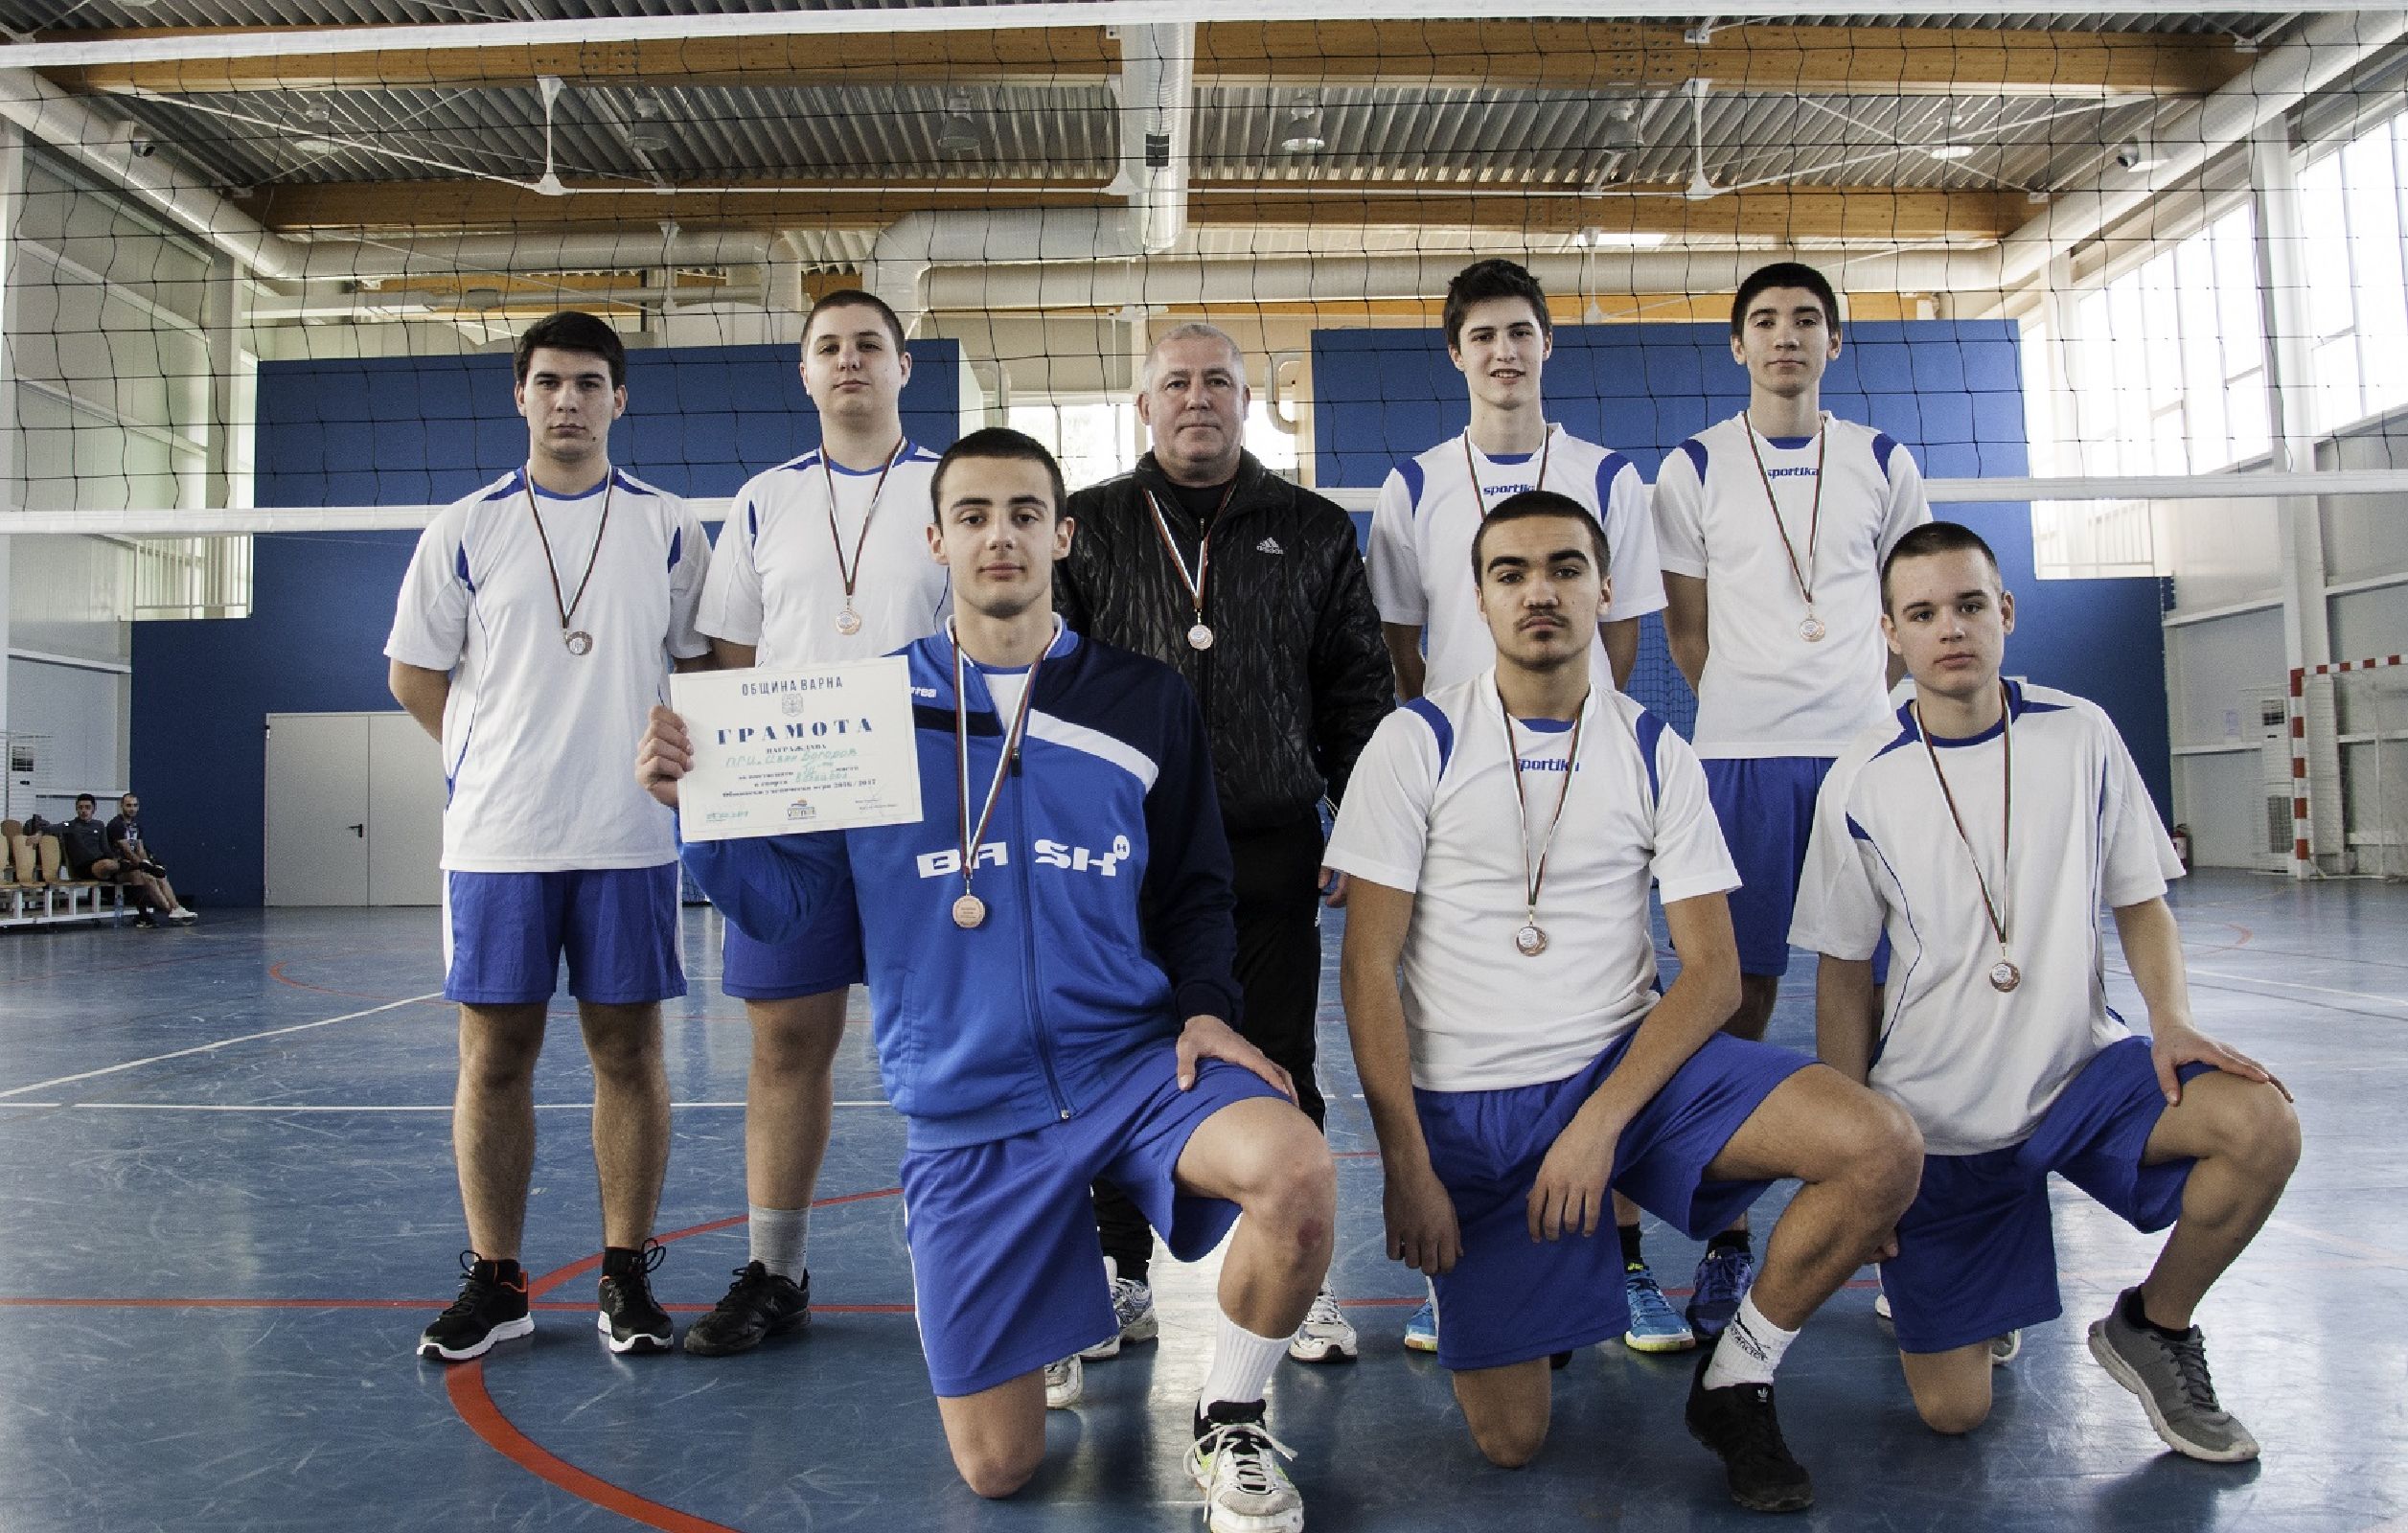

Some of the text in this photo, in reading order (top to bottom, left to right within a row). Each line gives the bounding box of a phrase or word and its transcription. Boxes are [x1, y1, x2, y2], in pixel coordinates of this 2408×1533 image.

[742, 676, 843, 697] ОБЩИНА ВАРНА
[717, 718, 873, 744] ГРАМОТА
[1516, 758, 1580, 771] portik
